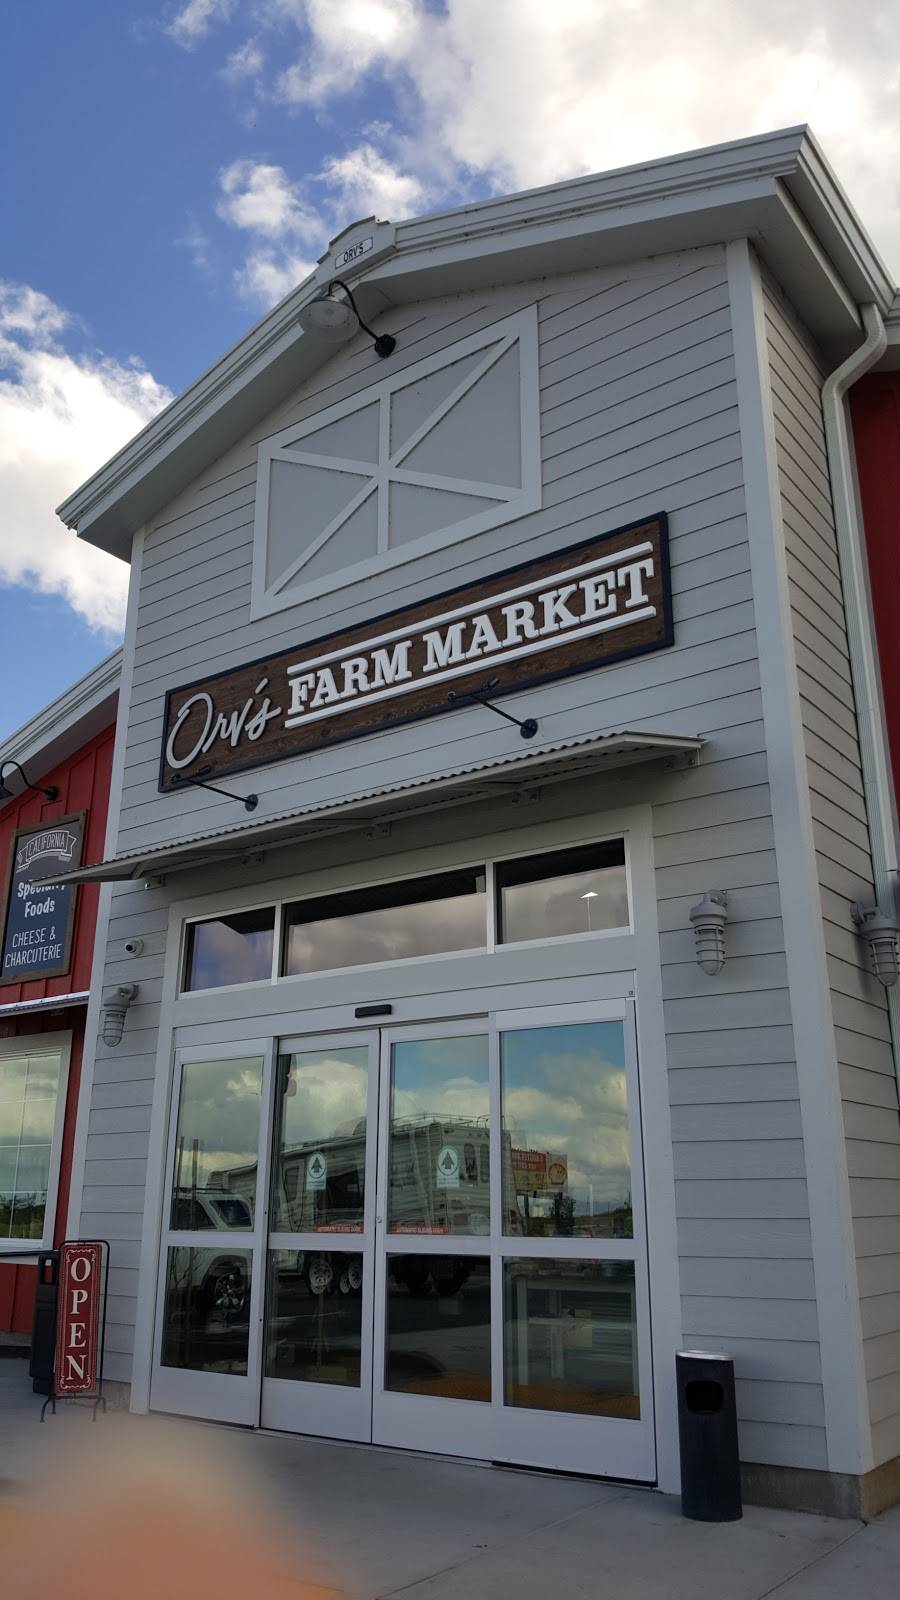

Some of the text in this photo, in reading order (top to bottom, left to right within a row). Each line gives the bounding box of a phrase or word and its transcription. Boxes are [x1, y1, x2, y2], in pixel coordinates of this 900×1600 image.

[166, 557, 654, 768] Orv's FARM MARKET
[28, 832, 66, 856] CALIFORNIA
[17, 882, 66, 900] Speca
[24, 897, 55, 918] Foods
[12, 926, 56, 948] CHEESE &
[5, 944, 62, 968] CHARCUTERIE
[66, 1257, 91, 1380] OPEN
